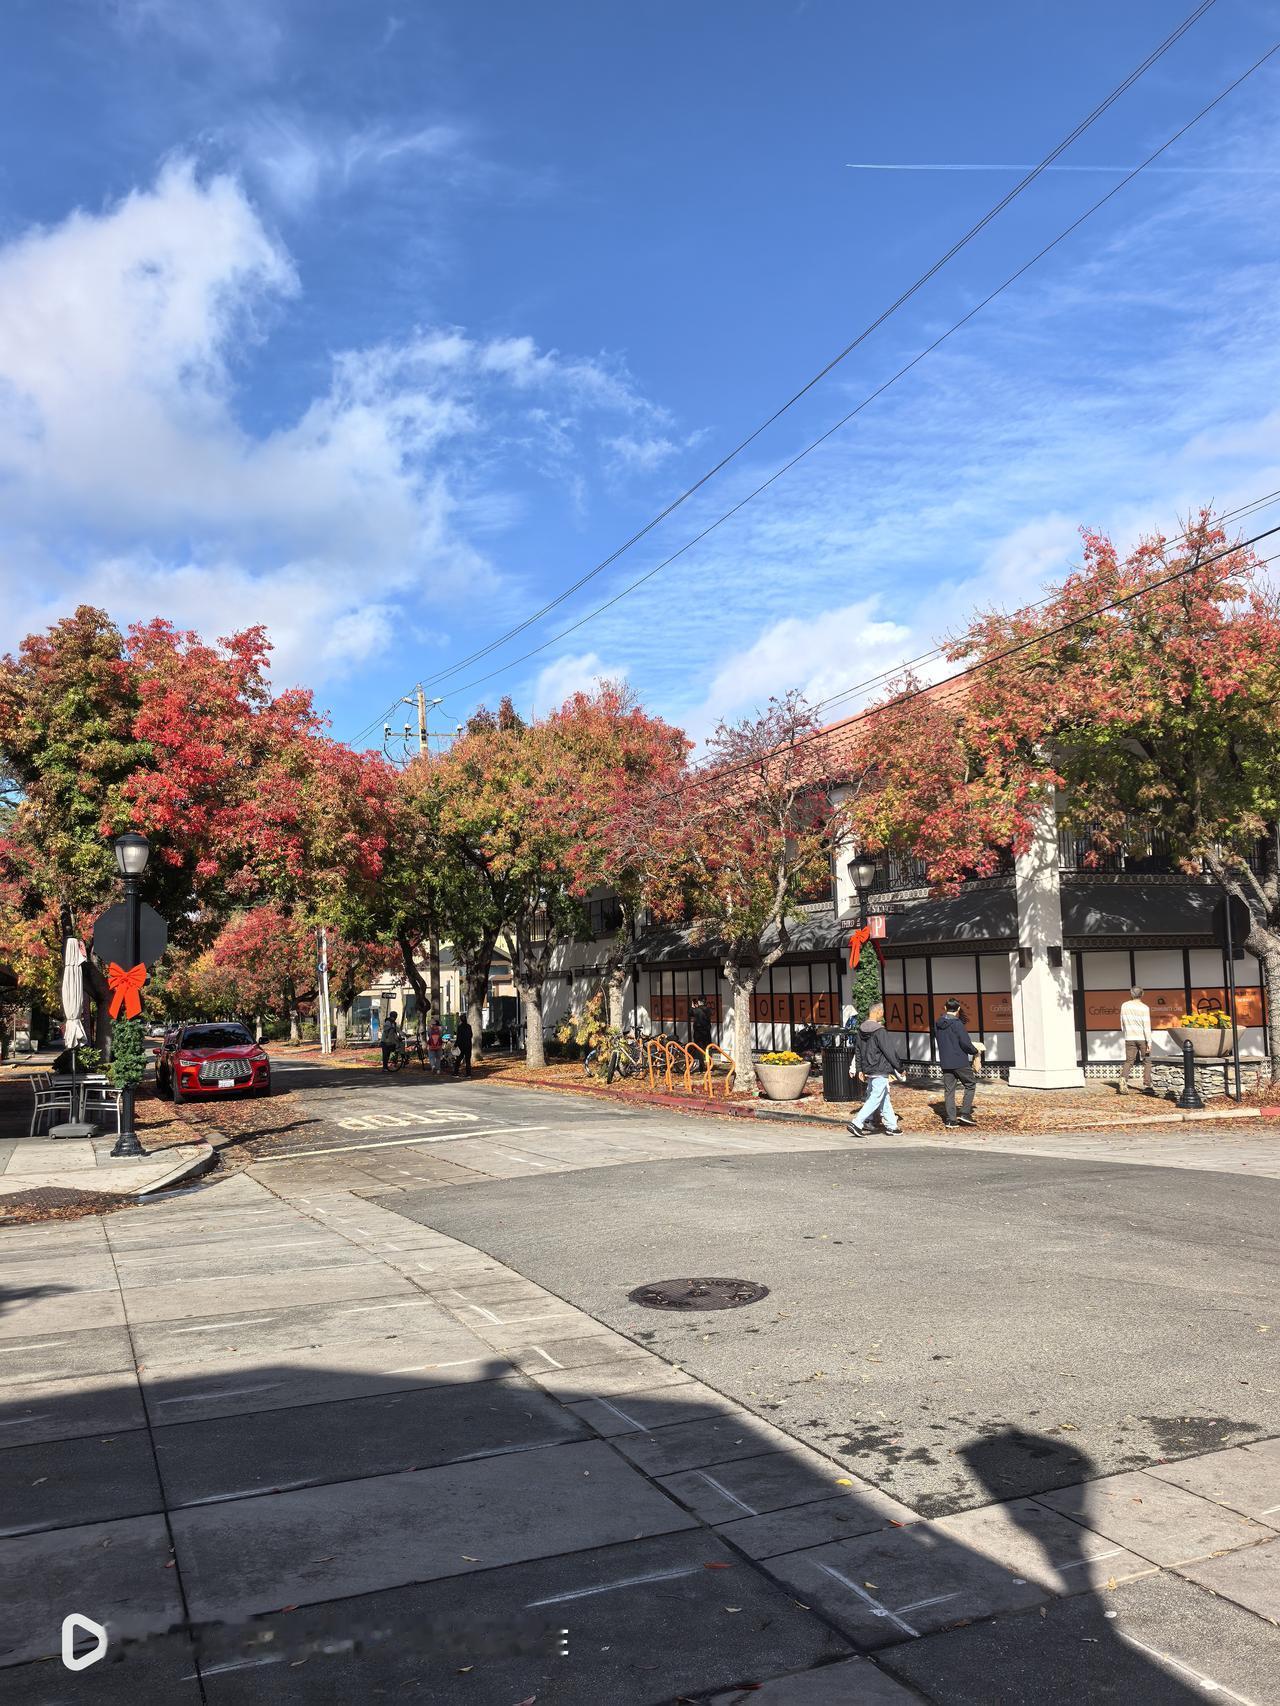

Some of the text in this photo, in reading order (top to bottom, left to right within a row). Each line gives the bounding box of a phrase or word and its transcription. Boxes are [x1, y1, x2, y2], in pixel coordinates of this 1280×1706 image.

[873, 916, 883, 937] P
[890, 1003, 924, 1024] AR
[337, 1109, 480, 1130] STOP
